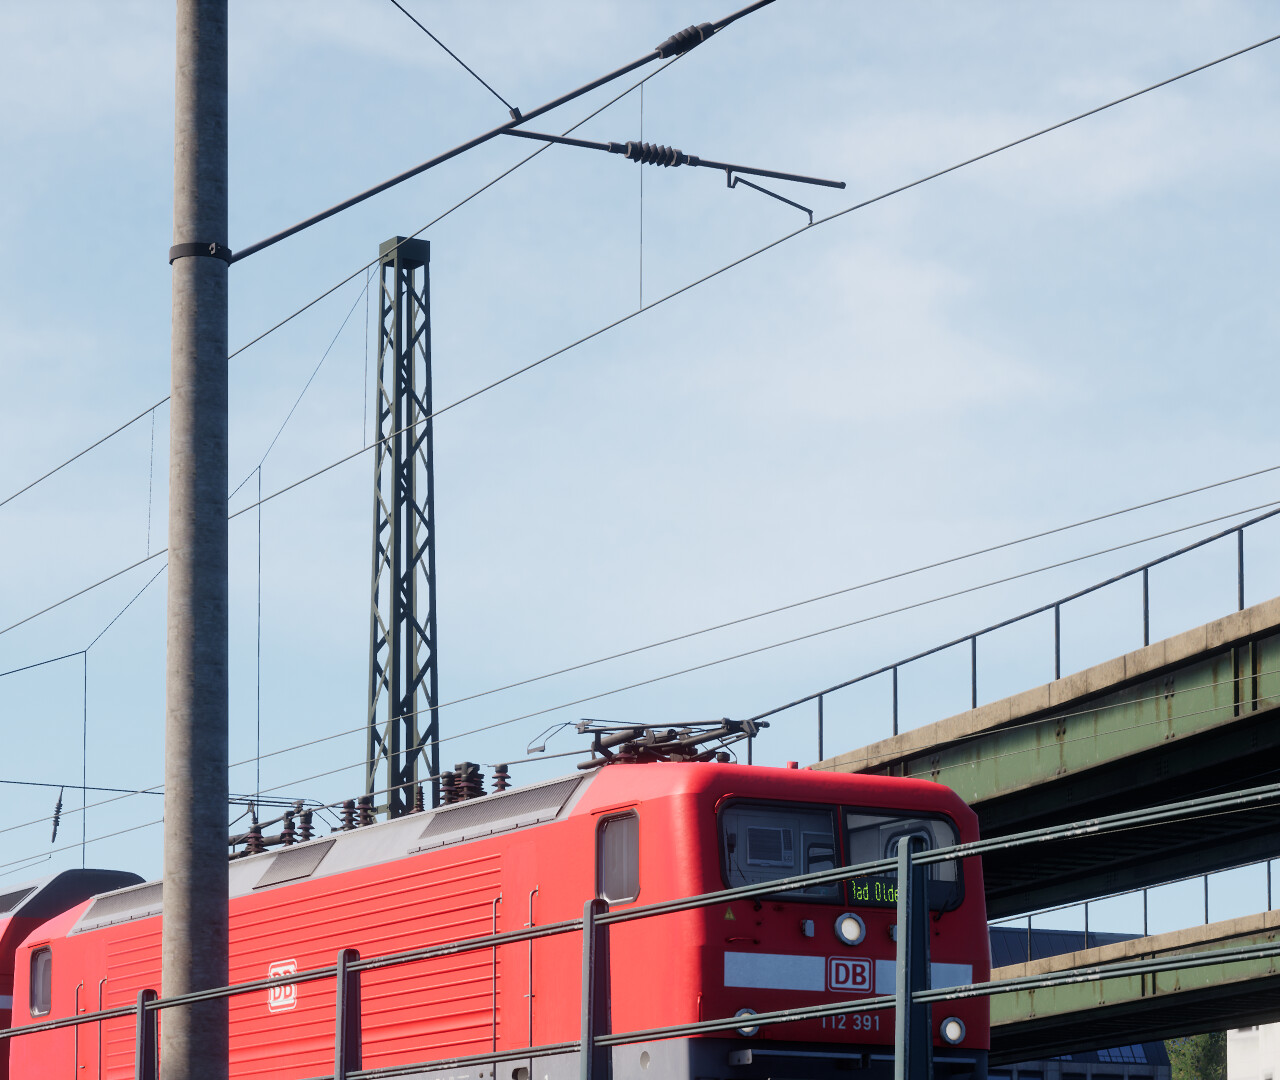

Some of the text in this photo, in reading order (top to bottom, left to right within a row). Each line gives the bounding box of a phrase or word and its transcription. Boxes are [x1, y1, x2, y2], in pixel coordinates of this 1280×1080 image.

[272, 970, 293, 1001] DB
[835, 962, 867, 986] DB
[822, 1014, 880, 1031] 112 391
